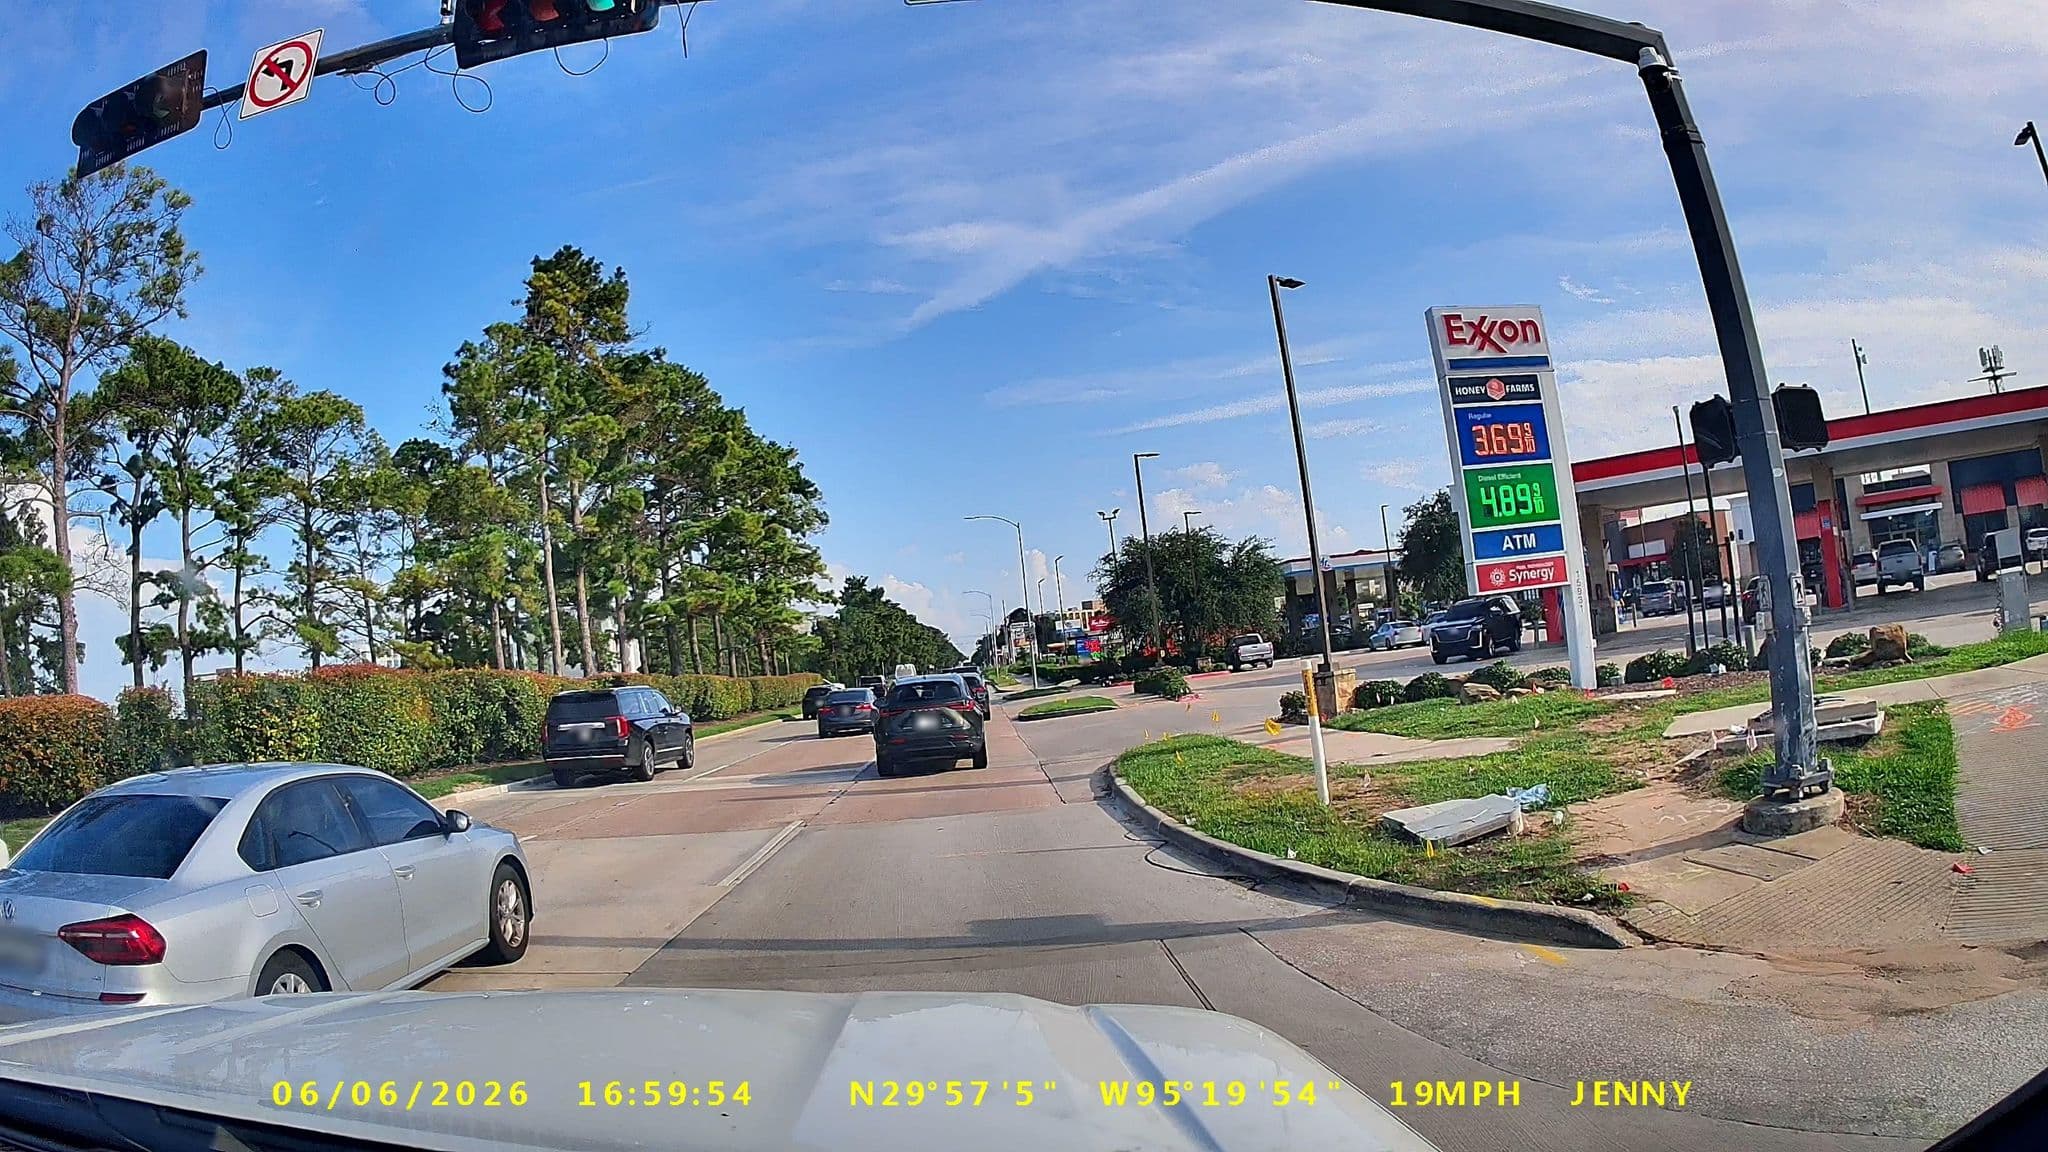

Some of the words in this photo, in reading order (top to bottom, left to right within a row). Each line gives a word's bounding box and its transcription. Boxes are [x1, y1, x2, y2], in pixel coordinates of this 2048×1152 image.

[1442, 315, 1541, 353] Exxon
[1455, 385, 1486, 396] HONEY
[1505, 383, 1535, 393] FARMS
[1472, 423, 1524, 456] 3.69
[1480, 483, 1533, 517] 4.89
[1502, 533, 1537, 551] ATM
[1508, 566, 1554, 585] Synergy
